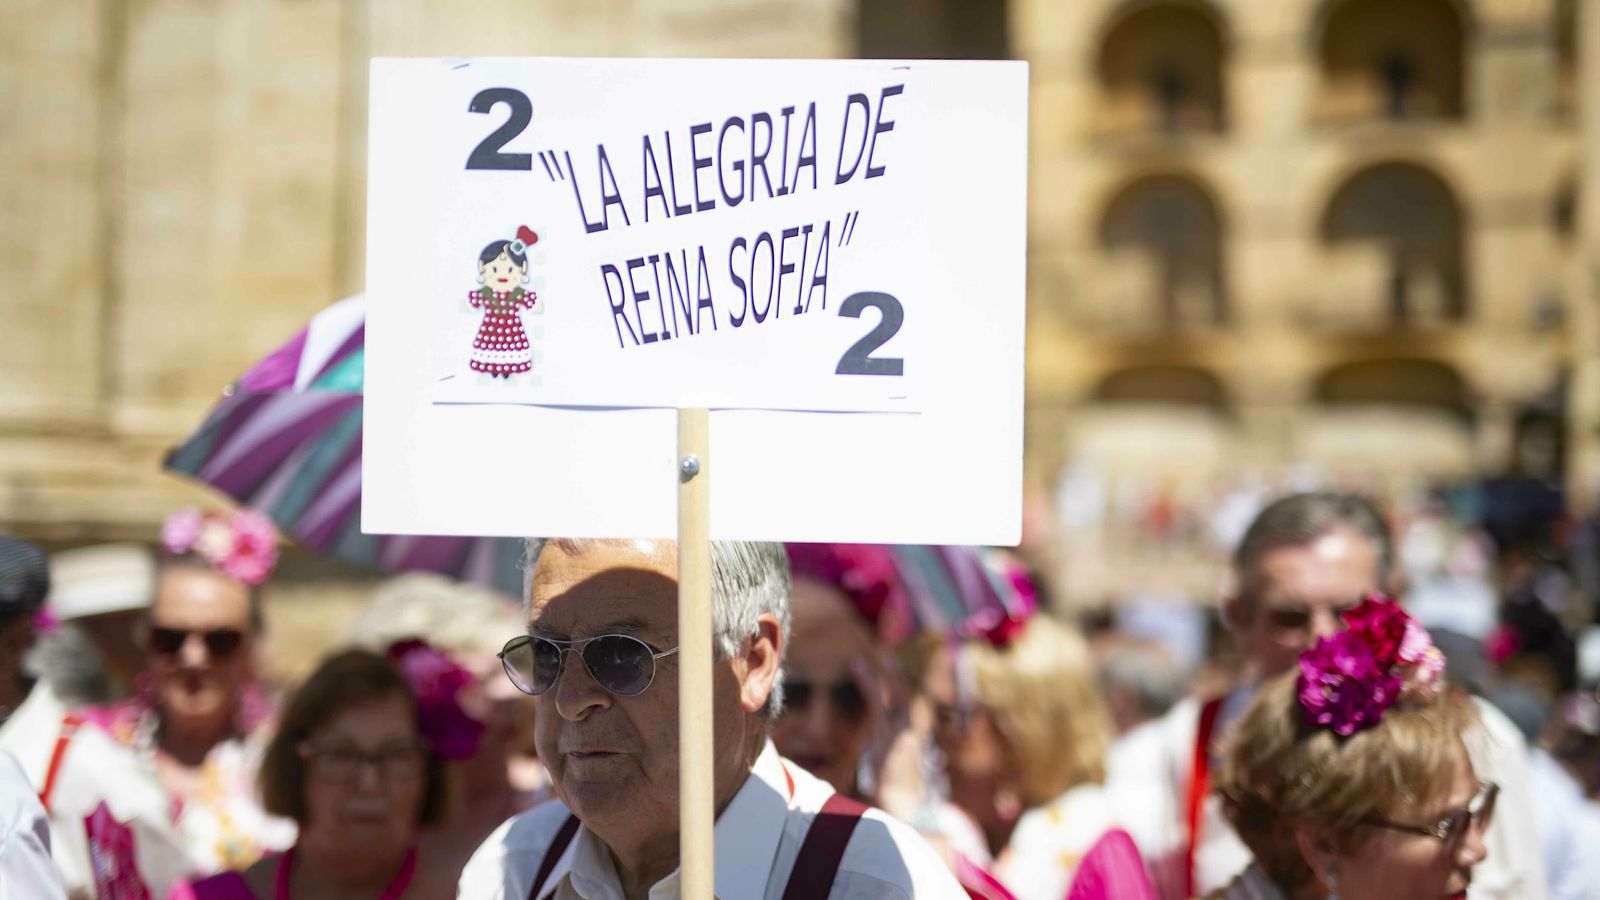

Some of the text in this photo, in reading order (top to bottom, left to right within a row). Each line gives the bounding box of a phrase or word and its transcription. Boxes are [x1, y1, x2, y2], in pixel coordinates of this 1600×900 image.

[465, 87, 533, 171] 2
[643, 101, 818, 223] ALEGRIA
[834, 84, 905, 187] DE
[600, 245, 718, 349] REINA
[835, 291, 905, 376] 2
